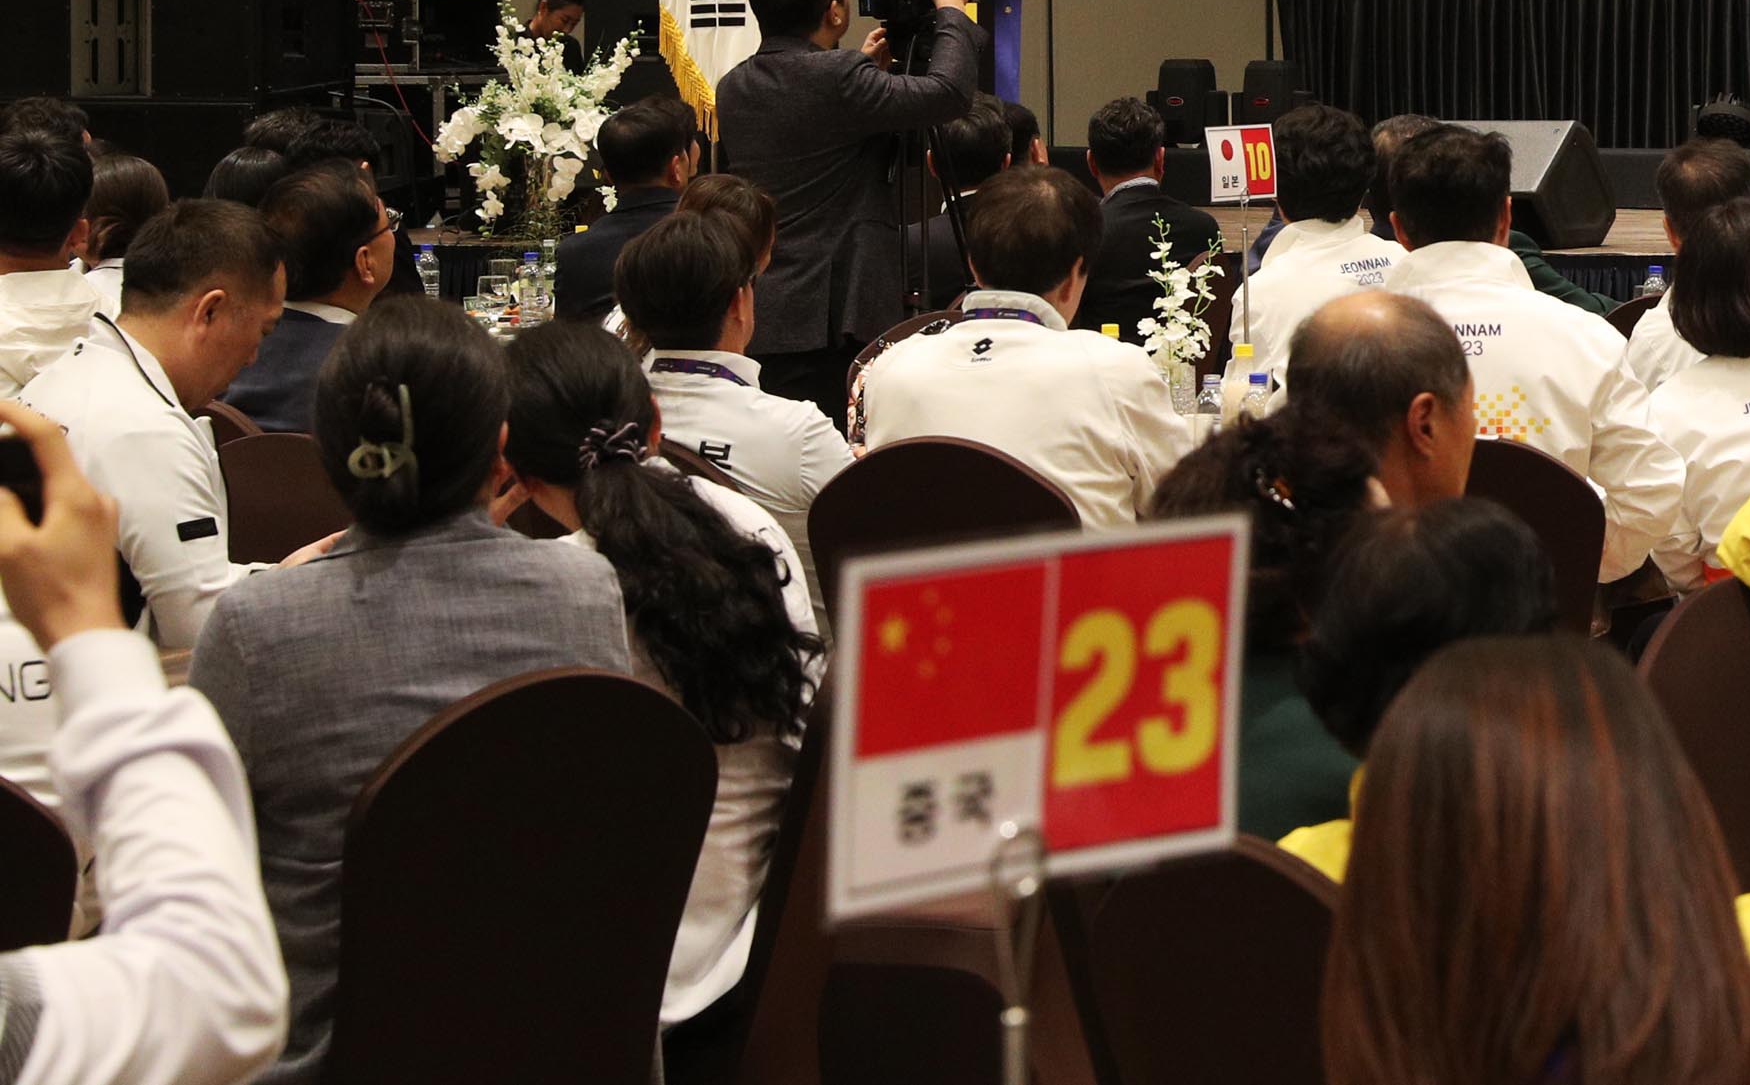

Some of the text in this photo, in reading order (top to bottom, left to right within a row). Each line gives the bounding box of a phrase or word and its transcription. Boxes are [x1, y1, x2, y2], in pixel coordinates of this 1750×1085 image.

[1245, 142, 1271, 181] 10
[1340, 257, 1391, 274] JEONNAM
[1356, 272, 1384, 286] 2023
[1050, 598, 1222, 789] 23
